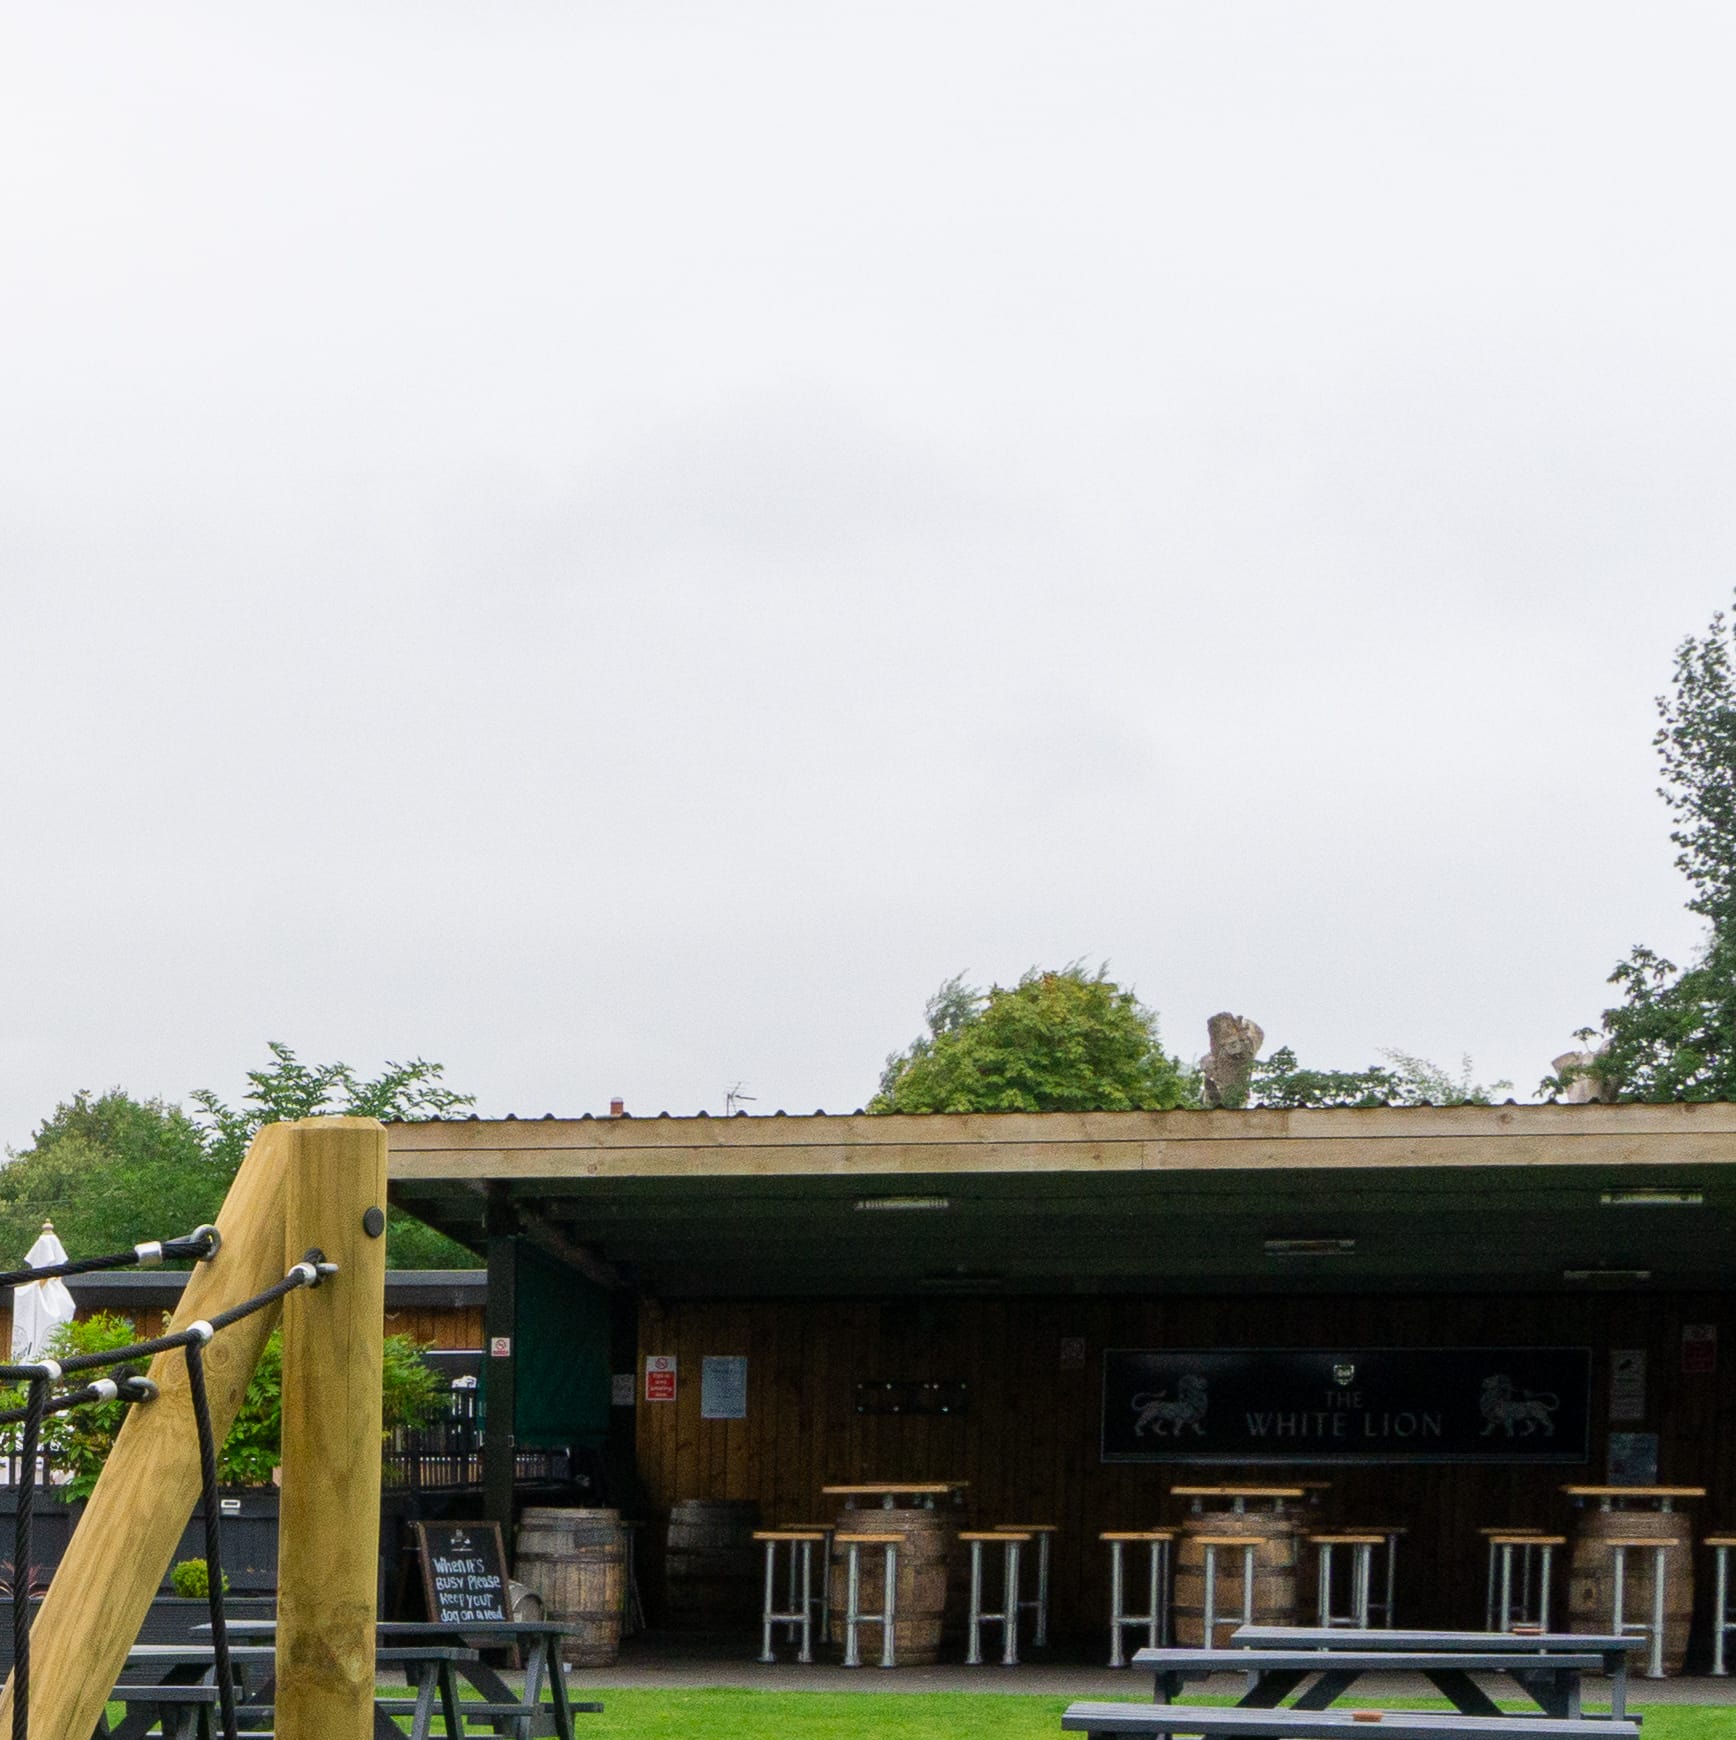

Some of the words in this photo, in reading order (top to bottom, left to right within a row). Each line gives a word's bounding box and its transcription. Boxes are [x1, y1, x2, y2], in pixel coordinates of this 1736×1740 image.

[1325, 1391, 1363, 1408] THE
[1245, 1412, 1345, 1437] WHITE
[1364, 1412, 1443, 1437] LION
[432, 1557, 466, 1573] When
[441, 1608, 460, 1624] dog
[460, 1610, 474, 1620] on
[476, 1610, 484, 1620] a
